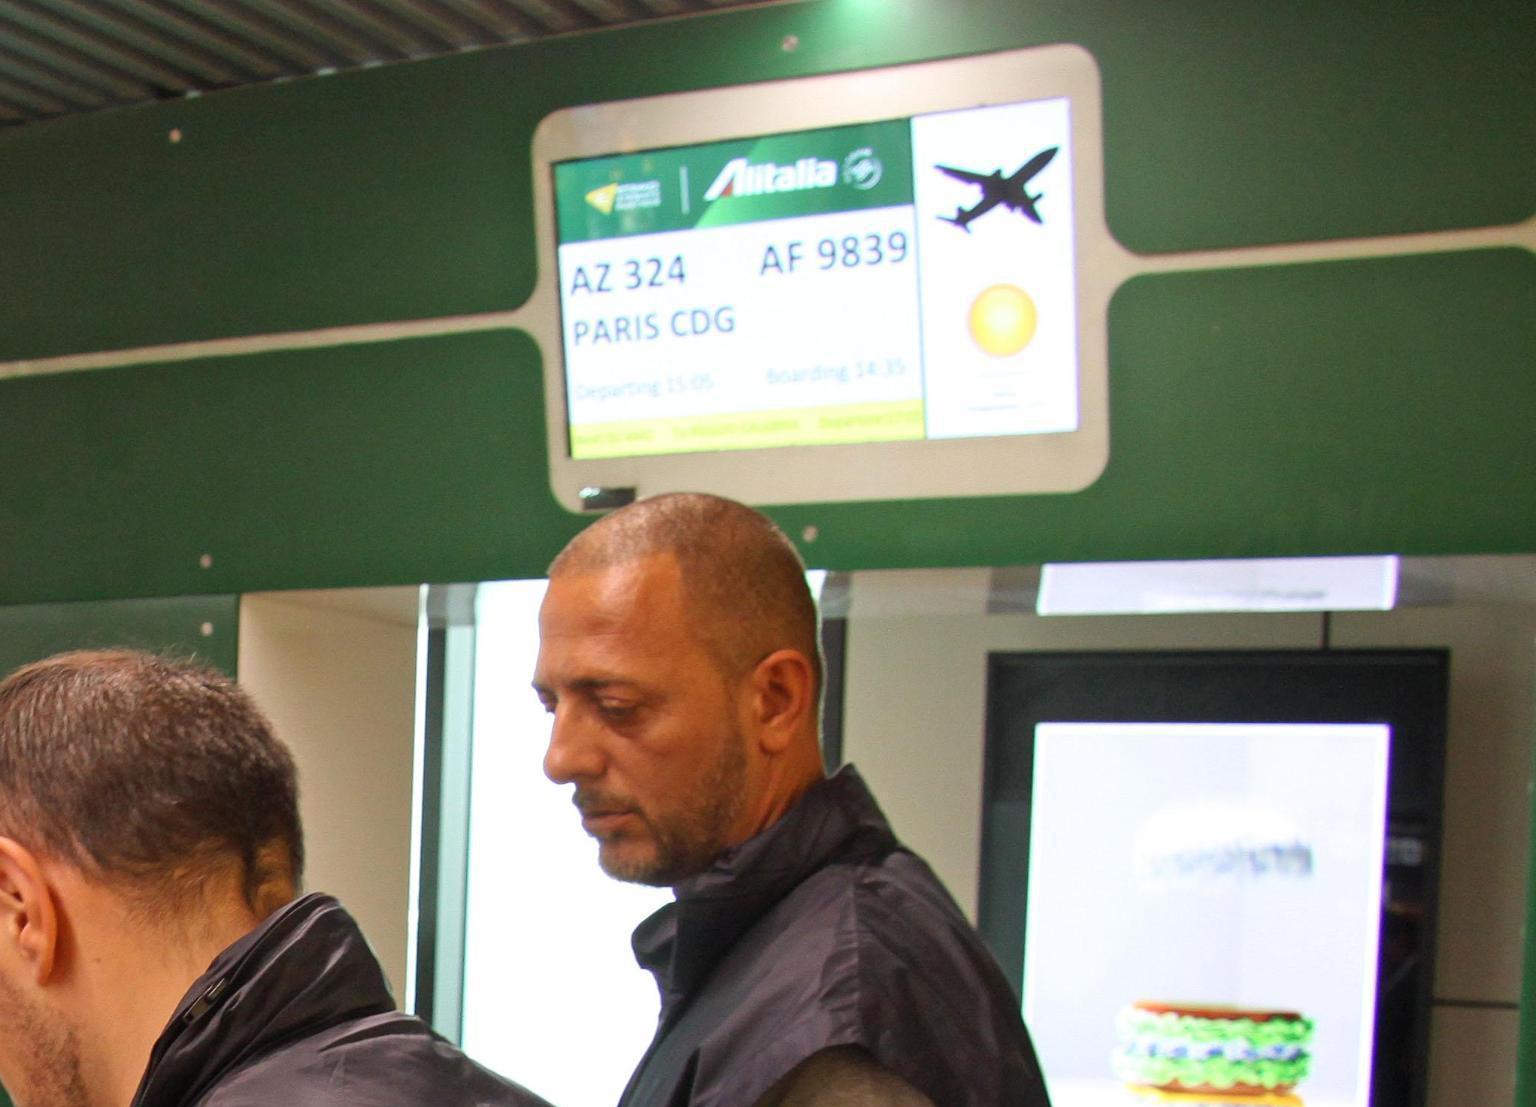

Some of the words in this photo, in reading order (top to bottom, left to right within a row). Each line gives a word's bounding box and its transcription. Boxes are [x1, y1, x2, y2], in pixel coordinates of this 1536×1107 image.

[703, 156, 838, 202] Alitalia
[760, 241, 805, 277] AF
[817, 230, 909, 272] 9839
[571, 263, 611, 296] AZ
[625, 254, 689, 290] 324
[573, 312, 659, 347] PARIS
[670, 306, 736, 337] CDG
[575, 380, 659, 402] Departing
[766, 365, 849, 386] Boarding
[855, 357, 907, 379] 14:35
